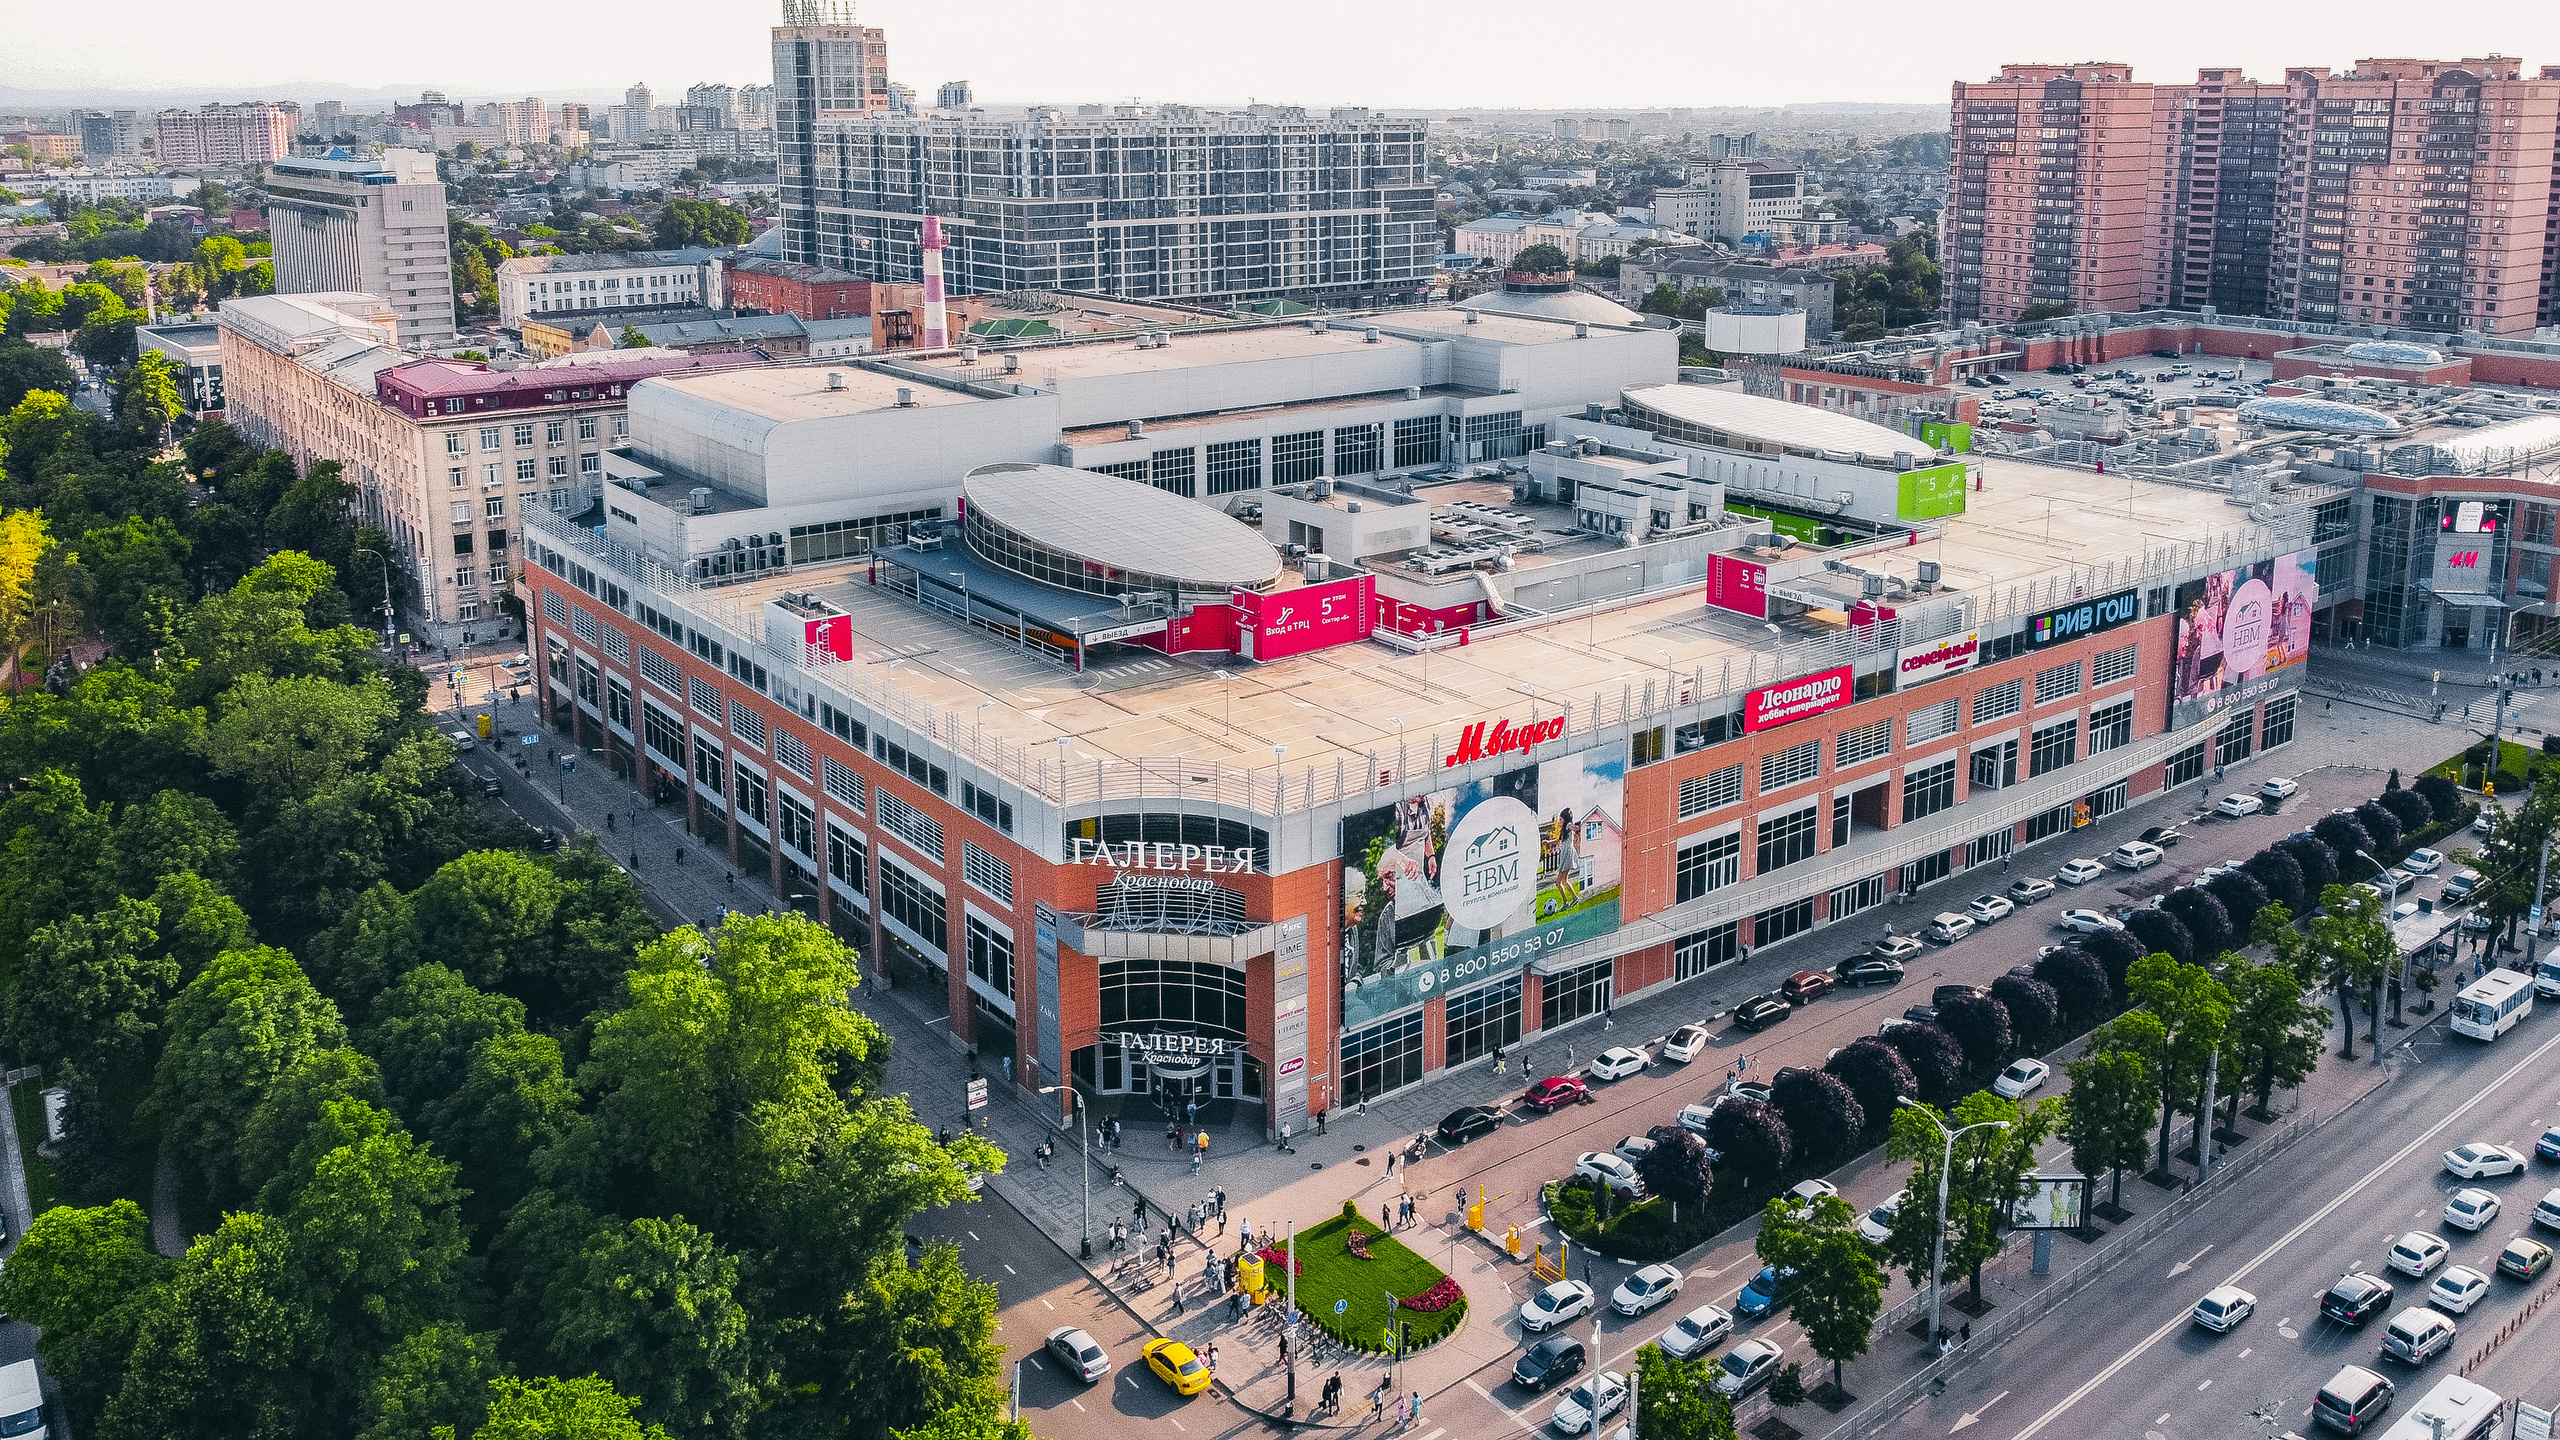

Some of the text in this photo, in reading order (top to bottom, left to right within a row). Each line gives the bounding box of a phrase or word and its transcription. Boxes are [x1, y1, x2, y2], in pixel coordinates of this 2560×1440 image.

[1929, 477, 1936, 491] 5
[1742, 569, 1749, 582] 5
[1321, 594, 1347, 616] 5 этаж
[1779, 589, 1803, 602] ВЫЕЗД
[1321, 616, 1340, 625] Сектор
[2054, 594, 2134, 638] РИВ ГОШ
[1102, 629, 1129, 640] ВЫЕЗД
[1266, 620, 1310, 636] Вход в ТРЦ
[1758, 676, 1842, 711] Леонардо
[2217, 677, 2279, 709] 8 800 550 53 07
[1757, 693, 1841, 724] хобби-гипермаркет
[1071, 837, 1257, 875] ГАЛЕРЕЯ
[1111, 869, 1214, 894] Краснодар
[1463, 859, 1519, 897] НВМ
[1288, 922, 1303, 932] KFC
[1279, 942, 1303, 957] LIME
[1440, 927, 1565, 983] 8 800 550 53 07
[1120, 1031, 1225, 1055] ГАЛЕРЕЯ
[1142, 1050, 1201, 1068] Краснодар
